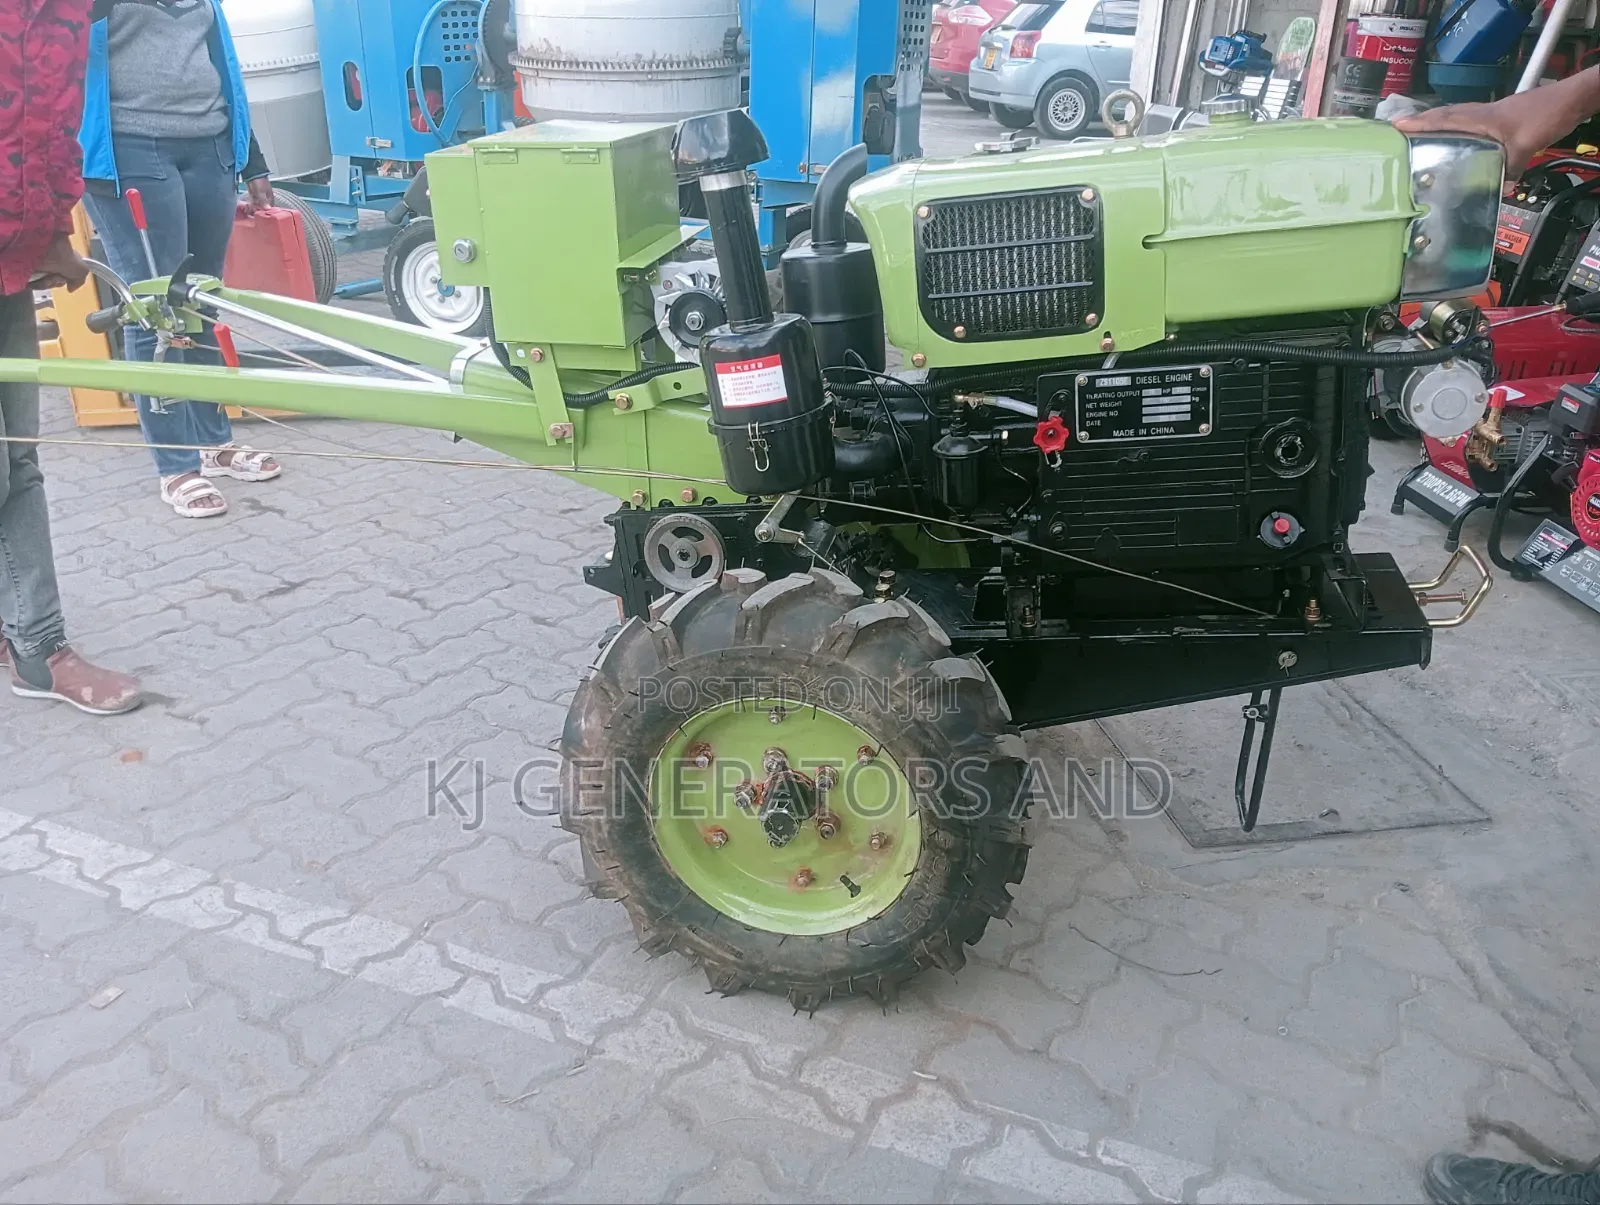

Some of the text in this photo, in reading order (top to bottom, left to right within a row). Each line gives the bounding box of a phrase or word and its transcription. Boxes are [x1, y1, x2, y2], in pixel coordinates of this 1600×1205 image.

[1136, 375, 1162, 385] DIESEL
[1165, 373, 1193, 383] ENGINE
[1117, 390, 1141, 398] OUTPUT
[1099, 400, 1123, 408] WEIGHT
[1113, 427, 1175, 437] MADE IN CHINA
